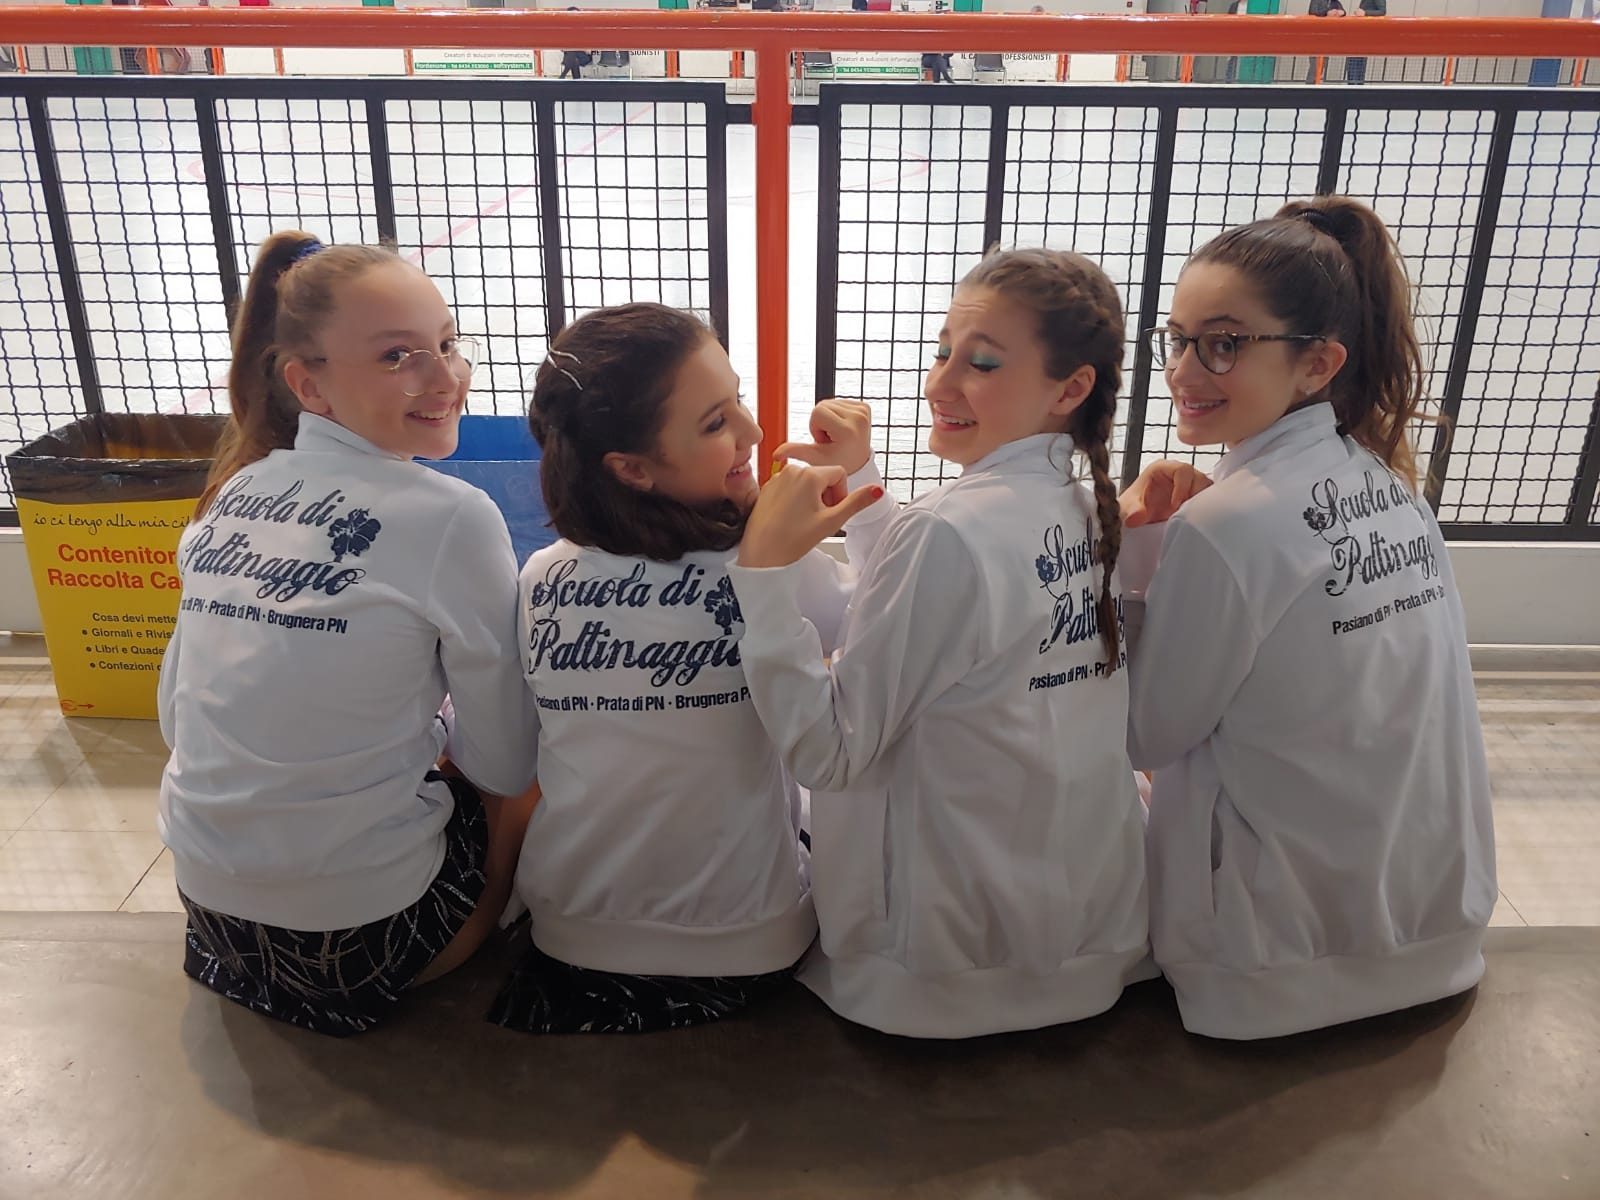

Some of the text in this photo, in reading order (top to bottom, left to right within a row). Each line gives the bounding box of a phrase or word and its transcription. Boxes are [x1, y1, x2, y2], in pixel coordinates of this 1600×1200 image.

[1002, 53, 1051, 61] OFESSIONISTI
[885, 66, 917, 74] softsystem.
[209, 475, 346, 528] Scuola di
[1311, 470, 1389, 530] Scuola
[34, 513, 190, 536] io ci tengo alla mia cit
[58, 543, 177, 565] Contenitor
[181, 525, 367, 603] Pattinaggio
[47, 568, 183, 590] Raccolta Ca
[532, 558, 705, 616] Scuola di
[92, 612, 177, 624] Cosa devi mette
[208, 600, 237, 617] Prata
[245, 605, 261, 622] PN
[267, 607, 325, 631] Brugnera
[326, 617, 348, 634] PN
[1332, 612, 1374, 635] Pasiano
[1394, 595, 1421, 614] Prata
[91, 628, 133, 638] Giornali
[145, 629, 175, 639] Rivis
[95, 645, 119, 653] Libri
[130, 645, 166, 655] Quade
[98, 660, 154, 671] Confezioni
[1029, 671, 1066, 692] Pasiano
[1075, 664, 1088, 681] PN
[572, 696, 589, 711] PN
[596, 696, 631, 711] Prata
[632, 696, 643, 711] di
[645, 696, 665, 710] PN
[675, 690, 739, 709] Brugnera
